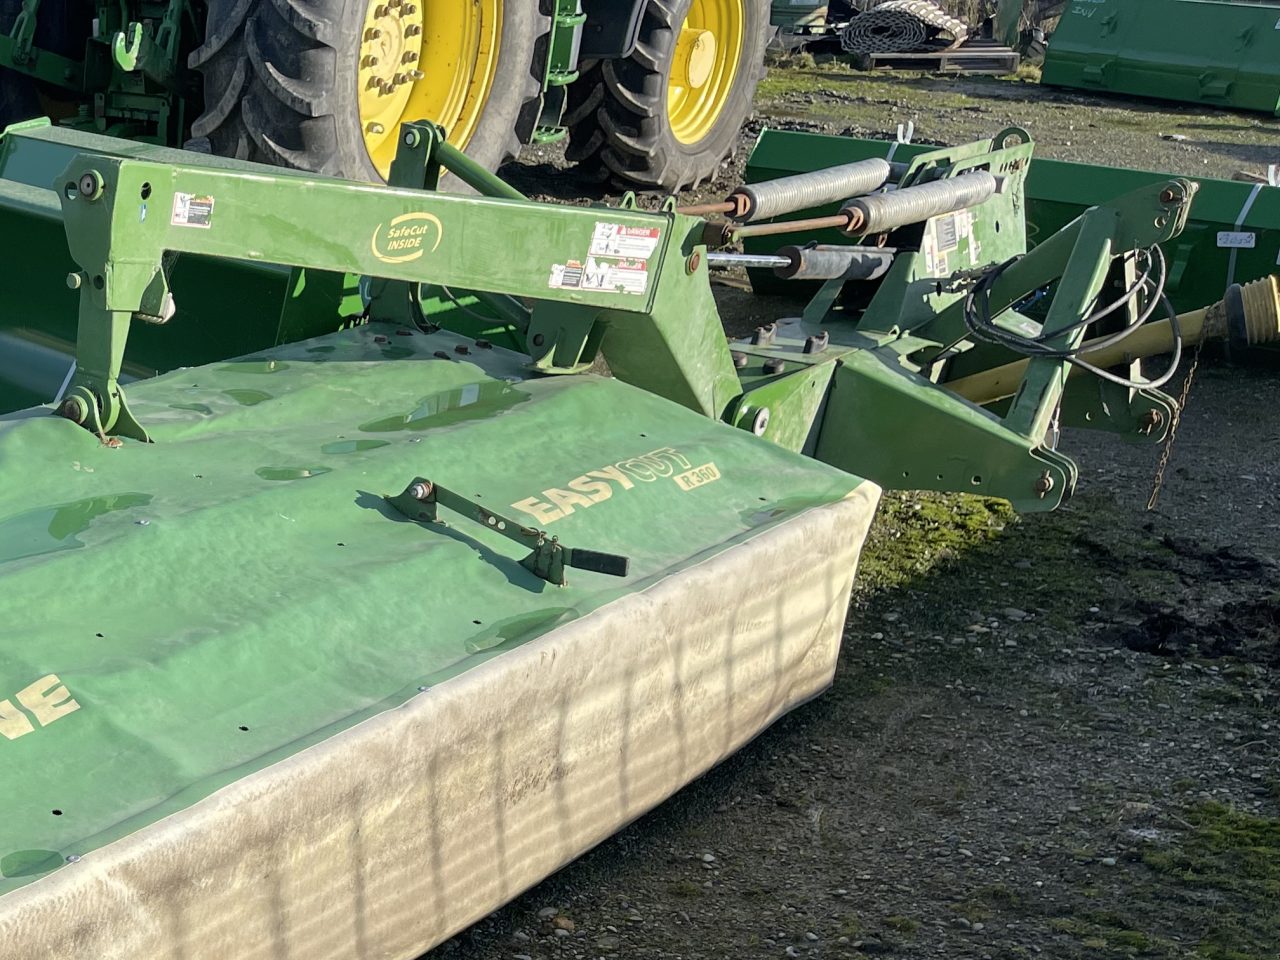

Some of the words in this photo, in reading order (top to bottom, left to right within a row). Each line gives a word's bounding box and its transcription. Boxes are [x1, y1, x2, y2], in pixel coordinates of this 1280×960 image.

[387, 225, 428, 239] SafeCut
[387, 237, 422, 250] INSIDE
[680, 475, 694, 488] R
[695, 465, 718, 484] 360
